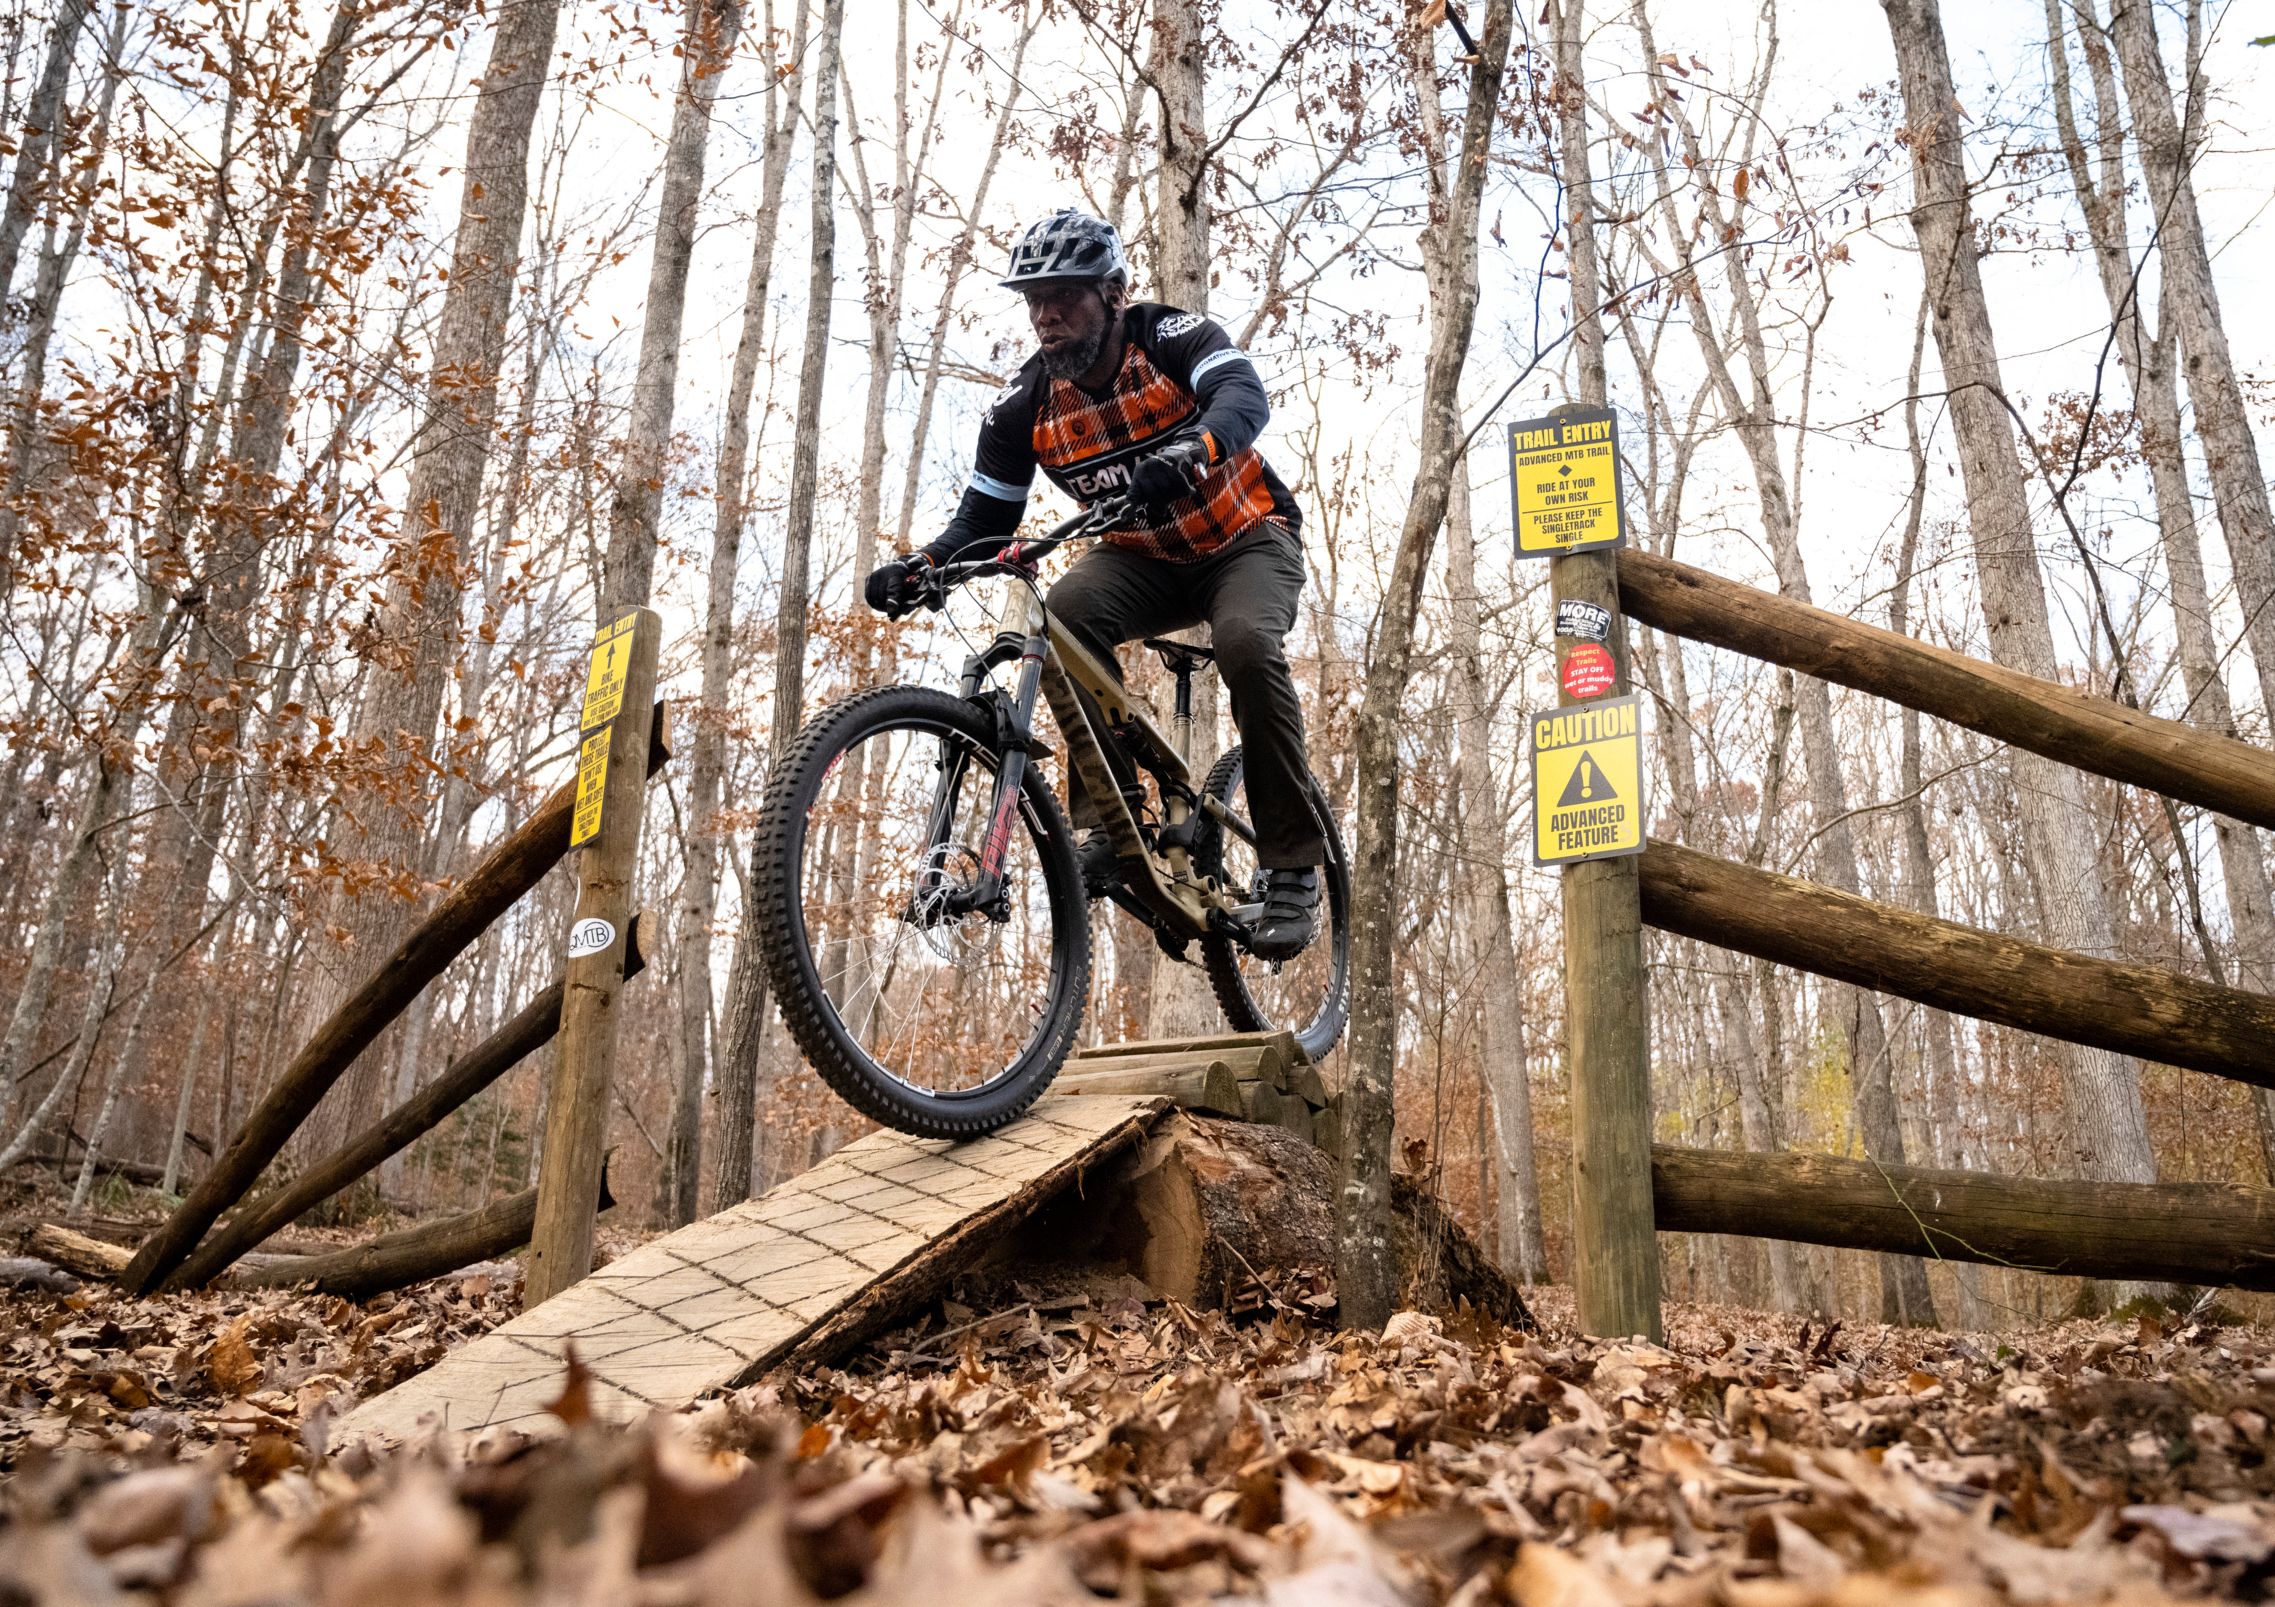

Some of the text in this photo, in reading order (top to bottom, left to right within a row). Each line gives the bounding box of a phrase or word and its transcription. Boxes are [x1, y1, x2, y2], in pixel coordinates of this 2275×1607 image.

[1514, 420, 1612, 450] TRAIL ENTRY
[1519, 446, 1610, 467] ADVANCED MTB TRAIL
[1065, 463, 1132, 499] TEAM
[1537, 477, 1596, 494] RIDE AT YOUR
[1545, 491, 1589, 506] OWN RISK
[1534, 507, 1602, 525] PLEASE KEEP THE
[1542, 519, 1596, 535] SINGLETRACK
[1555, 531, 1584, 544] SINGLE
[1560, 603, 1611, 625] MORE
[595, 611, 638, 646] TRAIL ENTRY
[1571, 648, 1600, 658] Respect
[1576, 657, 1598, 666] Trails
[601, 669, 614, 687] BIKE
[1570, 666, 1588, 677] STAY
[587, 677, 624, 705] TRAFFIC ONLY
[1564, 675, 1614, 689] wet or muddy
[1577, 684, 1599, 694] trails
[1535, 703, 1637, 750] CAUTION
[1551, 804, 1625, 833] ADVANCED
[1558, 825, 1619, 852] FEATURE
